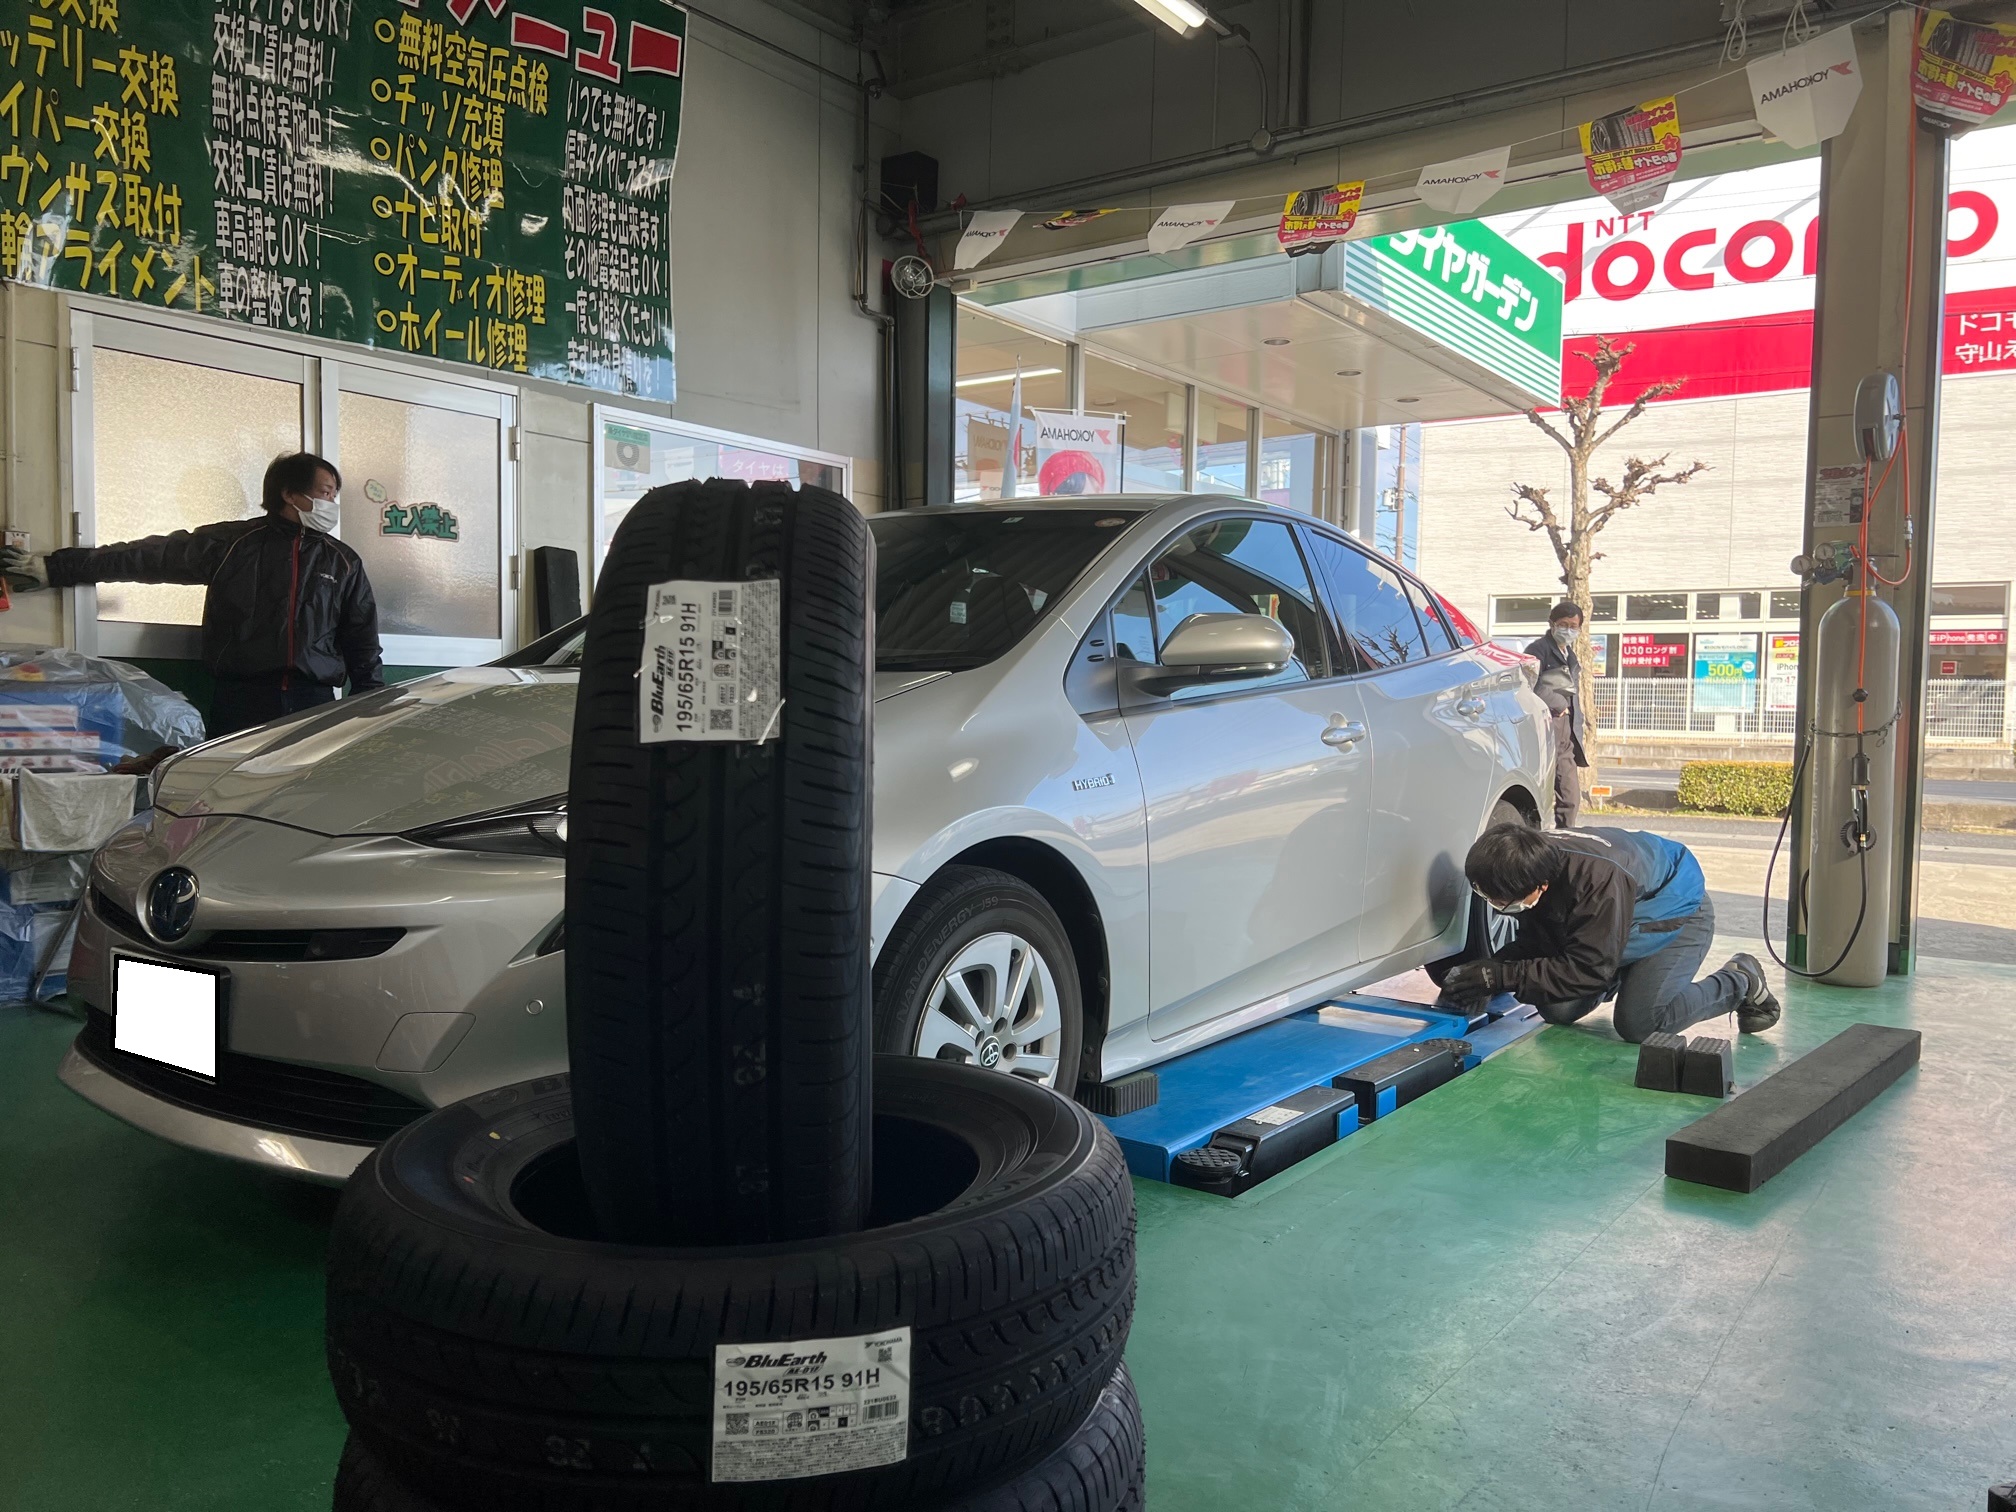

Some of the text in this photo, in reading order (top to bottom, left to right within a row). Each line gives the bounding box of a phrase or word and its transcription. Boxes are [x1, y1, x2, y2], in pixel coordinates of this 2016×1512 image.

[398, 10, 549, 116] 無料空気圧点検
[395, 74, 506, 157] チッソ充填
[396, 132, 505, 209] パンク修理
[395, 188, 483, 259] ナビ取付
[1536, 190, 1999, 305] docoo
[1595, 210, 1655, 239] NTT
[398, 243, 546, 325] オーディオ修理
[399, 301, 528, 373] ホイール修理
[382, 504, 458, 540] 立入禁止
[651, 644, 667, 716] BluEarth
[676, 602, 697, 733] 195/65R15 91H
[1074, 775, 1110, 791] HYBRID
[724, 1367, 880, 1397] 195/65R15 91H
[744, 1351, 828, 1369] BluEarth
